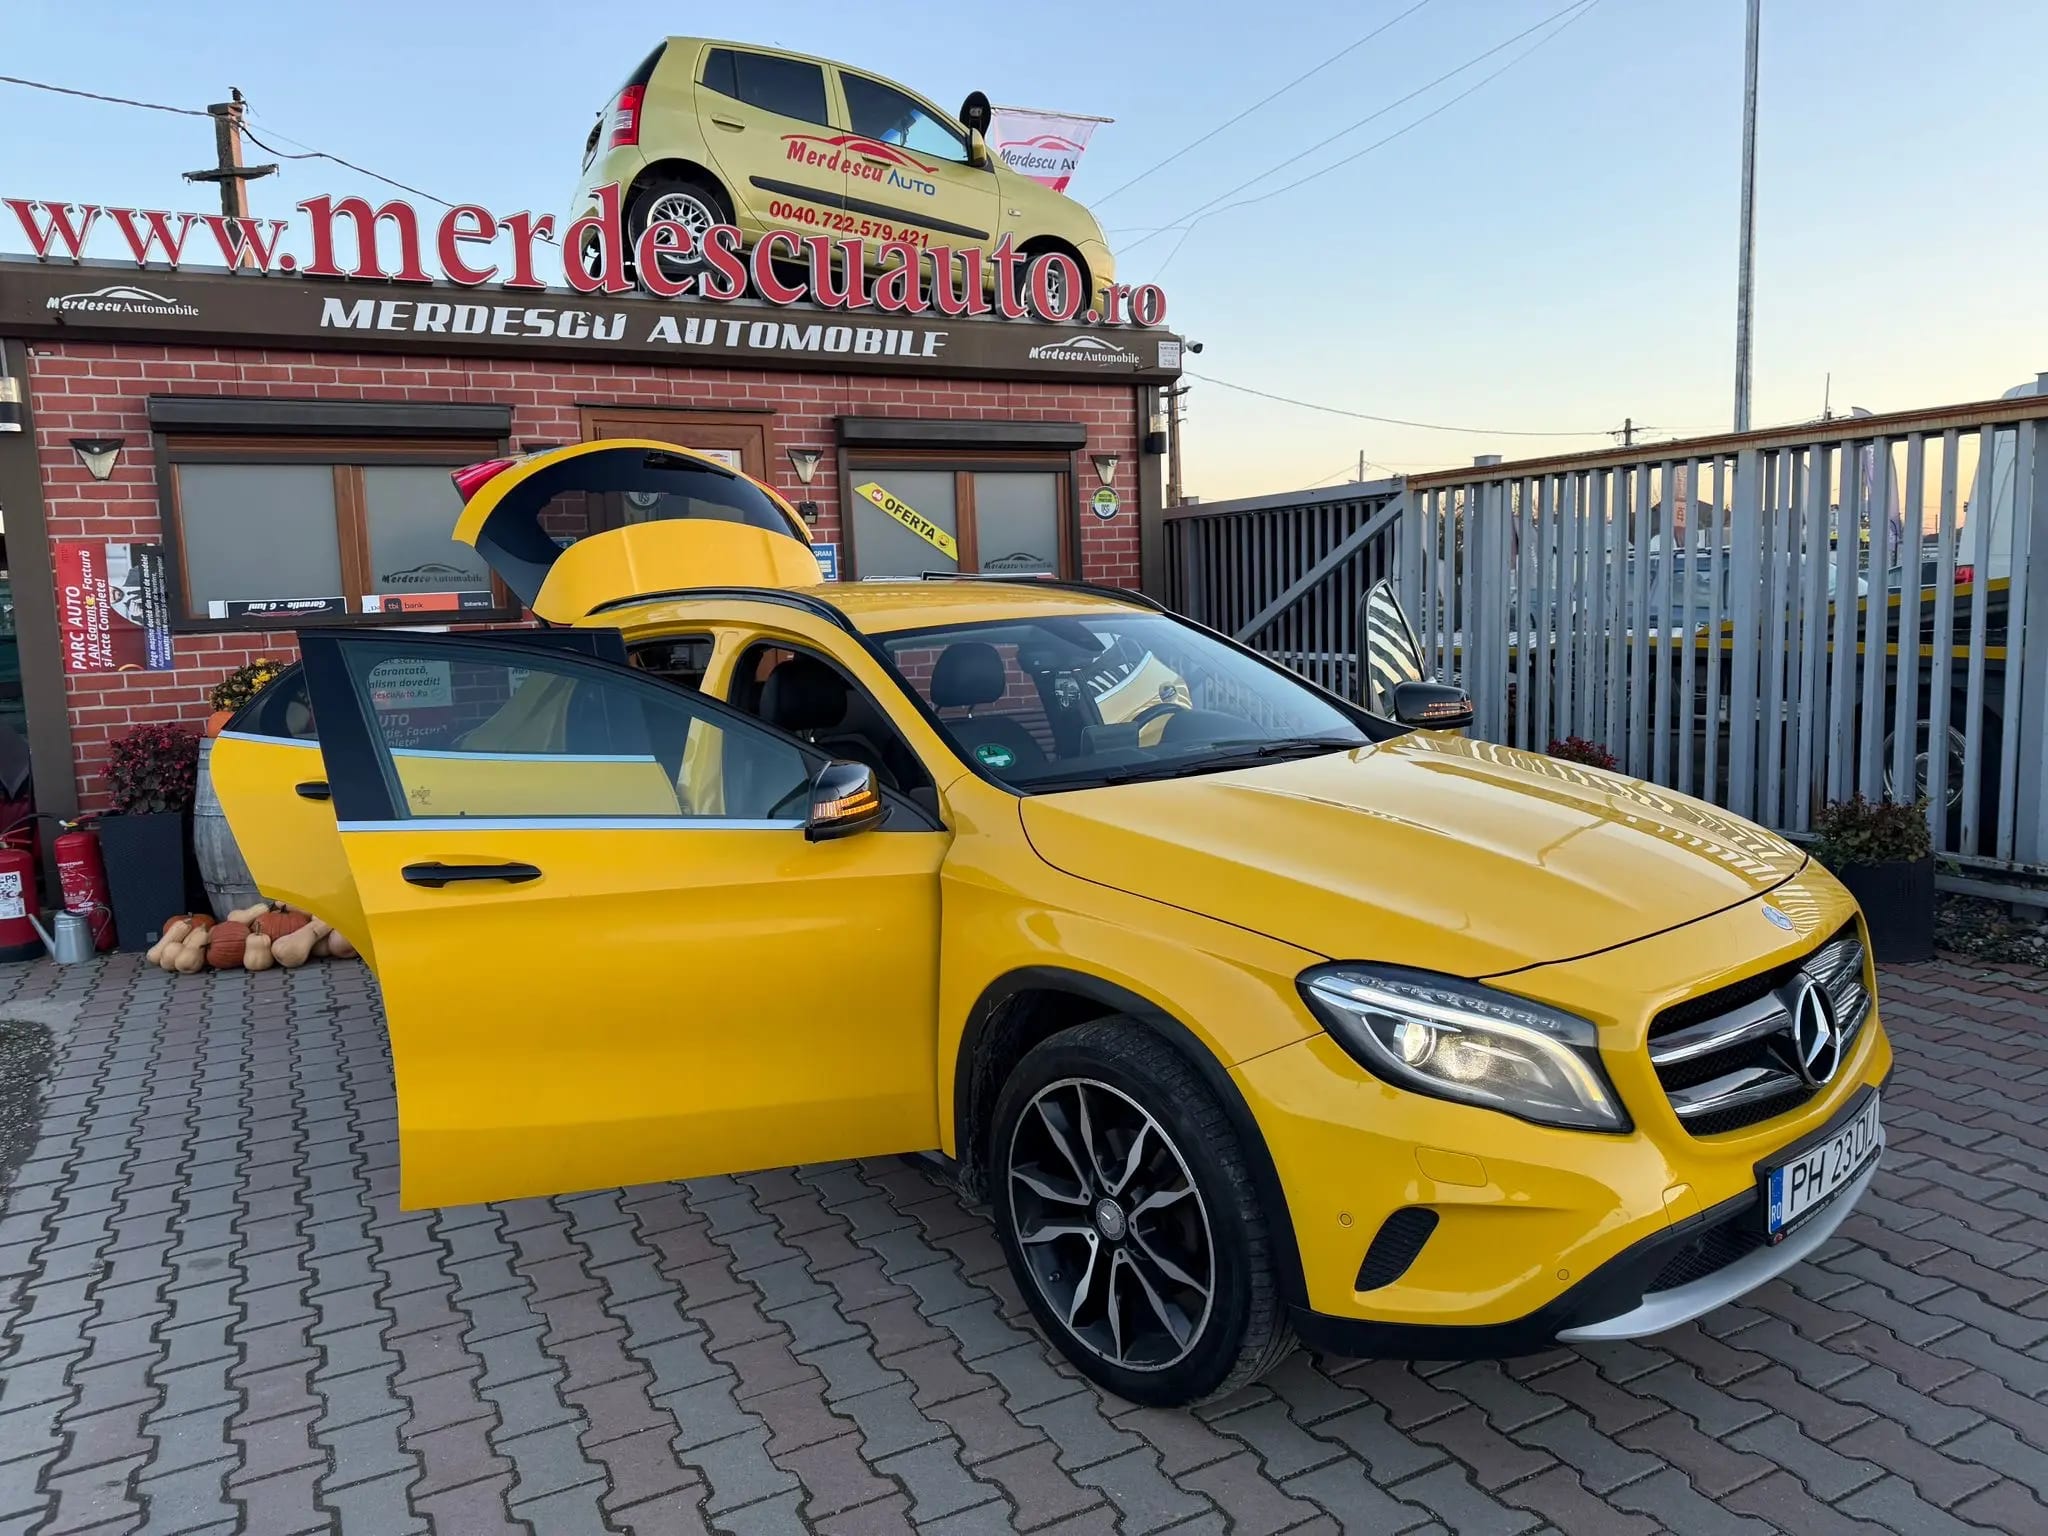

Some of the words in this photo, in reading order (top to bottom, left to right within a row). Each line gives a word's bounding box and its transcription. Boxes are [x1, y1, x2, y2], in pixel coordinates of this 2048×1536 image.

[786, 140, 884, 183] Merdescu
[1000, 148, 1057, 170] Merdescu
[769, 200, 929, 248] 0040.722.579.421
[2, 181, 1166, 327] www.merdescuauto.ro
[320, 297, 627, 341] MERDESCU
[646, 316, 949, 357] AUTOMOBILE
[884, 498, 936, 540] OFERTA
[65, 586, 83, 627] AUTO
[95, 578, 110, 631] Complete!
[404, 601, 423, 609] bank
[69, 631, 87, 670] PARC
[88, 643, 99, 659] AN
[100, 634, 112, 656] Acte
[1790, 1151, 1825, 1212] PH
[1831, 1130, 1853, 1184] 23
[1771, 1202, 1782, 1225] RO
